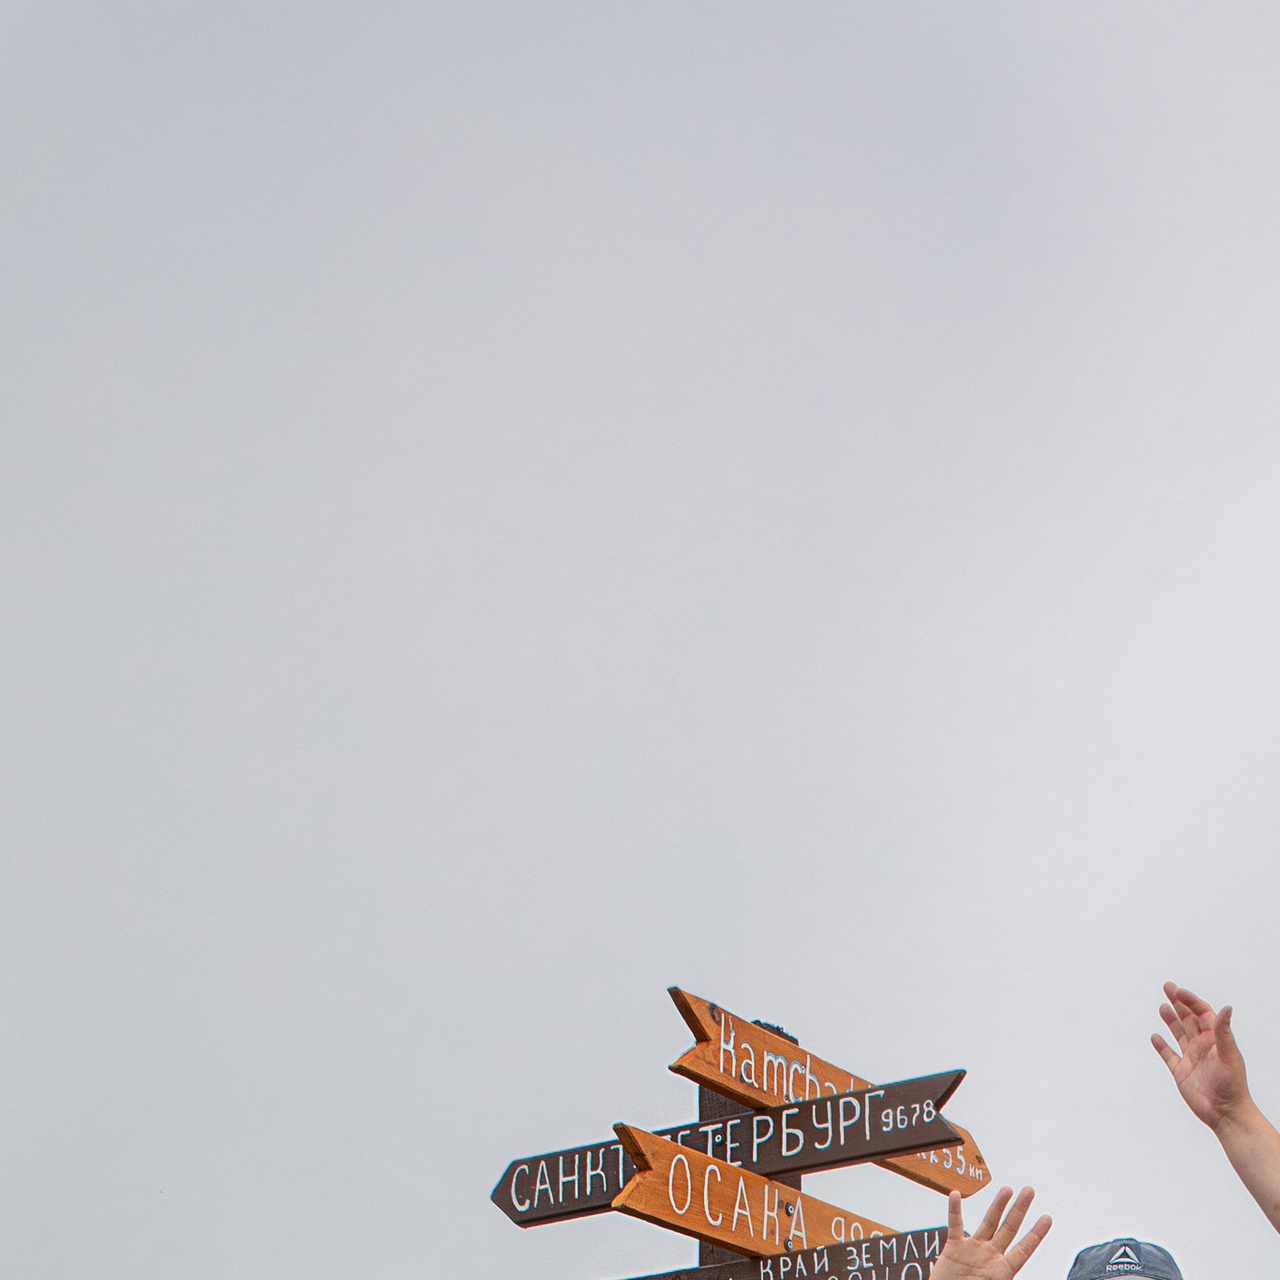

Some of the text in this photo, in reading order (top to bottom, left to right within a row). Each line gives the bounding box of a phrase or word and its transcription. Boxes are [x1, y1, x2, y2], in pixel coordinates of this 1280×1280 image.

[719, 1012, 871, 1105] Kamch
[881, 1099, 937, 1132] 9678
[668, 1153, 884, 1250] ОСАКА 90
[846, 1230, 940, 1271] ЗЕМЛИ
